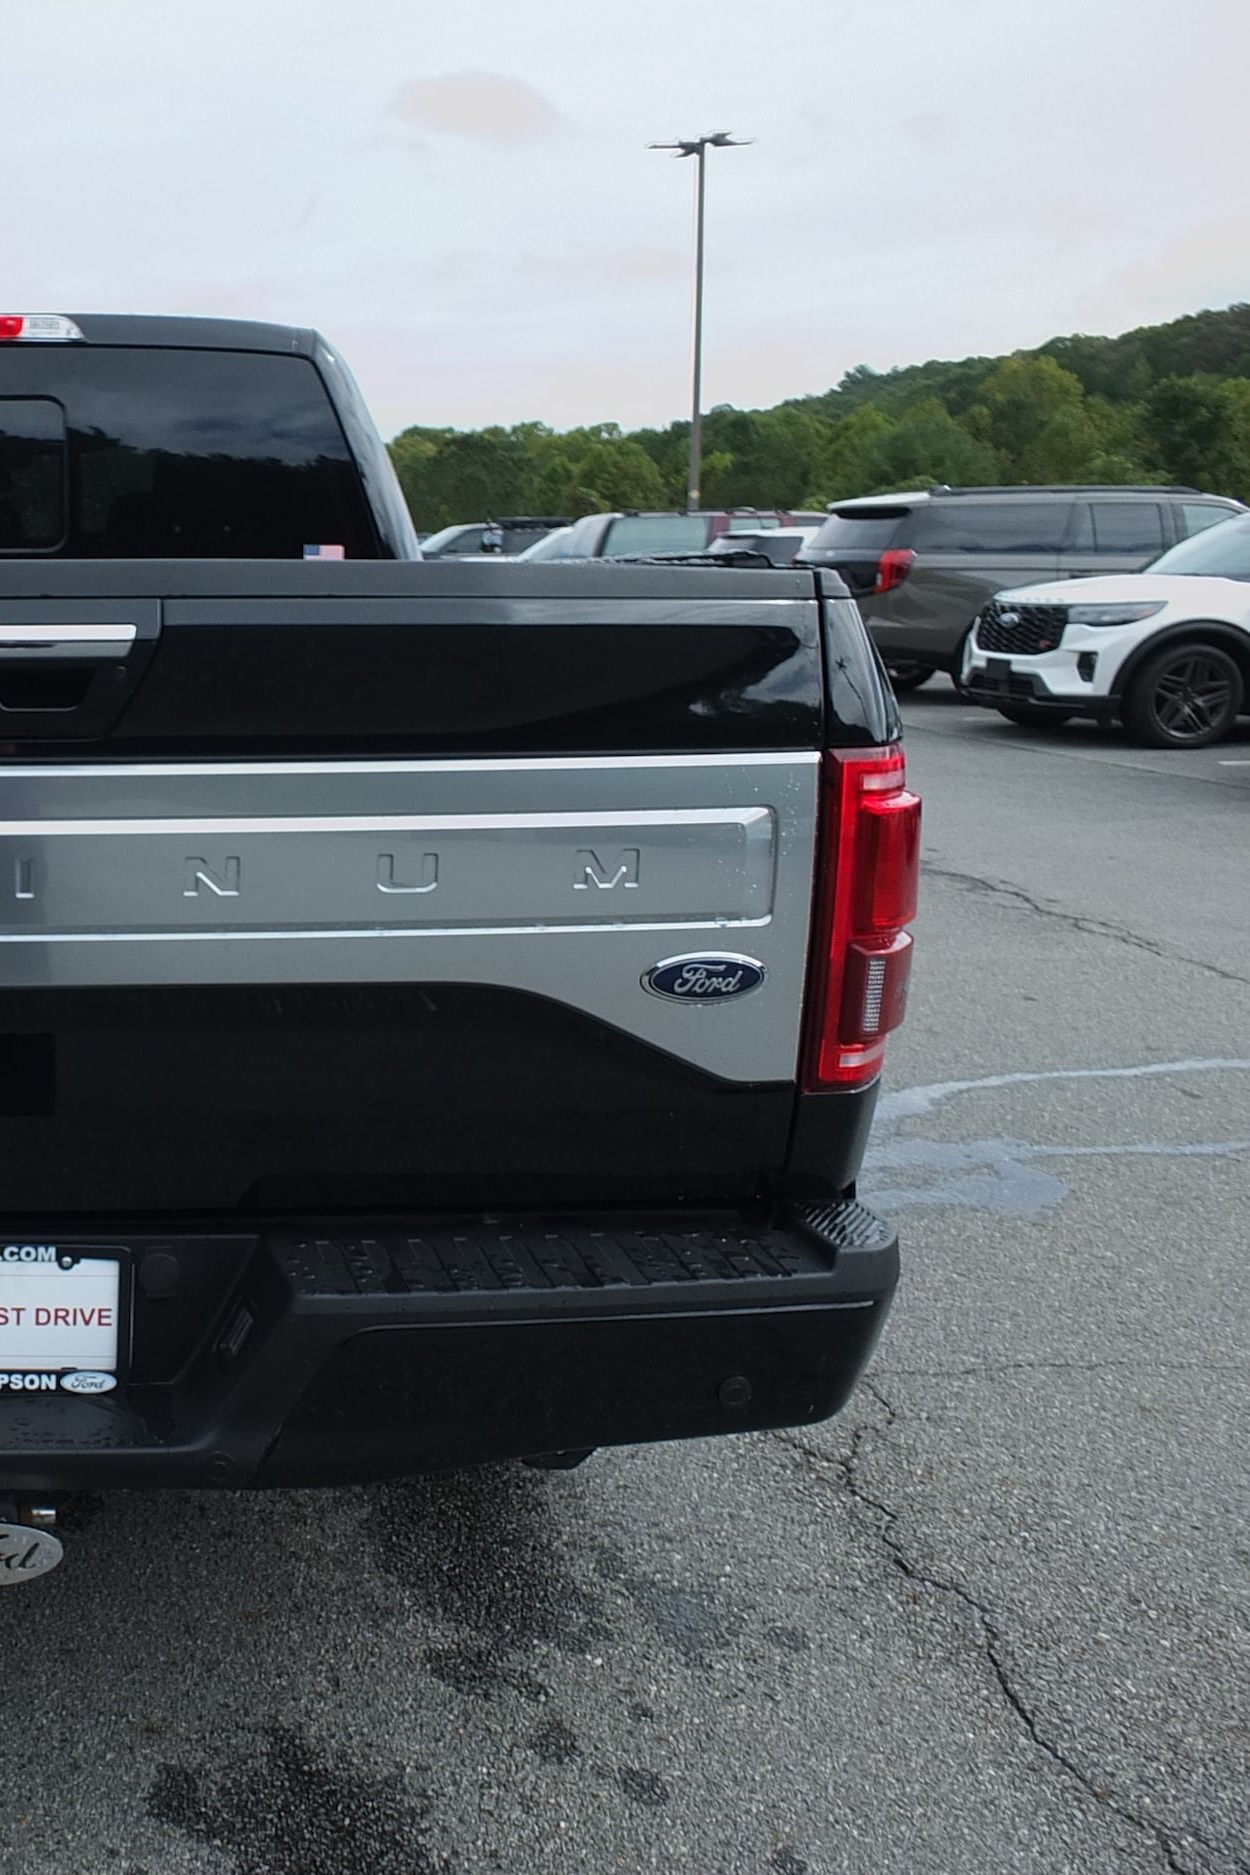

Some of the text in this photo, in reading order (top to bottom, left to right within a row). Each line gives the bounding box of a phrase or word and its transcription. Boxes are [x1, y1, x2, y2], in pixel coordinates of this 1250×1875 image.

[673, 963, 743, 994] Ford
[34, 1307, 113, 1327] DRIVE
[71, 1376, 106, 1390] Ford
